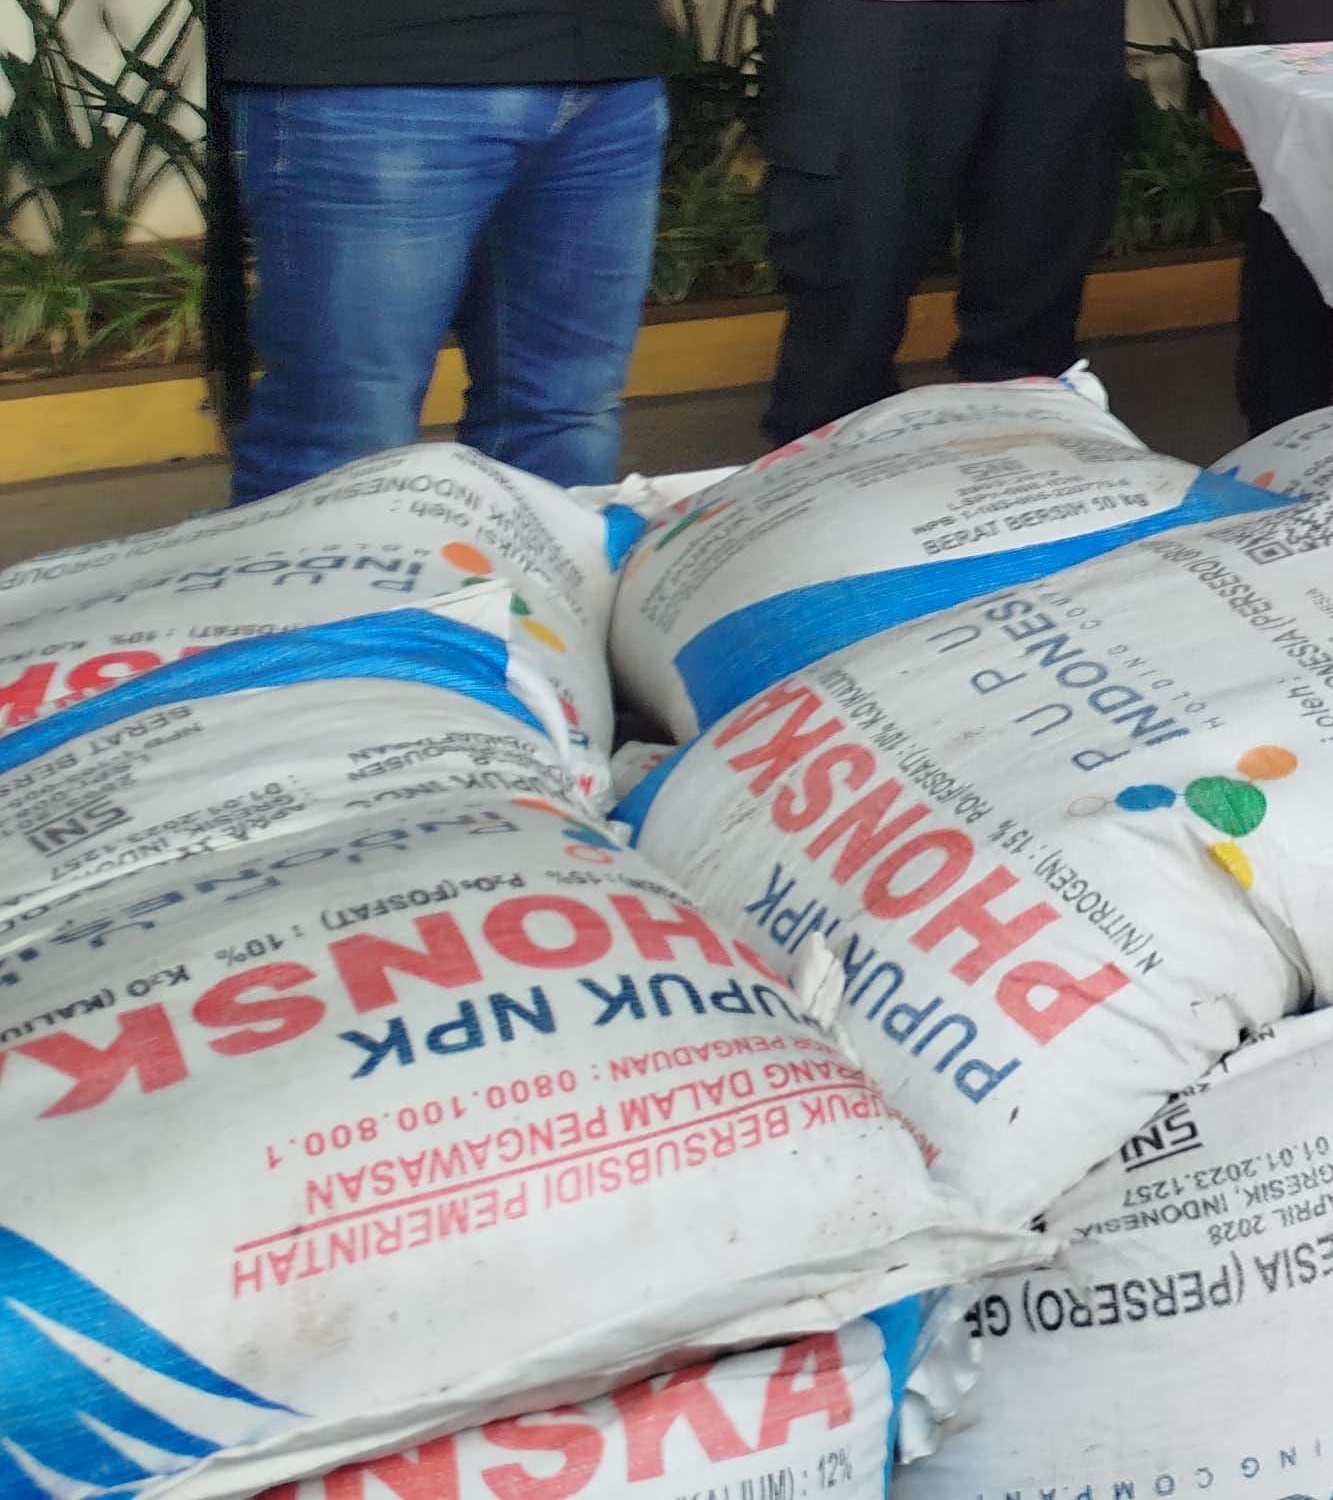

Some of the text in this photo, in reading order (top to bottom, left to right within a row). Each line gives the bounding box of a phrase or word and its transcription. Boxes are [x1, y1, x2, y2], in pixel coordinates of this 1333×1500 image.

[923, 501, 1089, 556] BERAT BERSIH
[978, 593, 1189, 750] INDONESI
[24, 798, 128, 858] SNI
[711, 678, 1131, 1047] PHONSKA
[214, 928, 287, 969] 10%
[0, 893, 788, 1120] HONSK
[339, 986, 552, 1079] NPK
[610, 1035, 785, 1084] PENGADUAN
[304, 1066, 751, 1216] DALAM PENGAWASAN
[231, 1103, 789, 1298] BERSUBSIDI PEMERINTAH
[1073, 1194, 1227, 1243] INDONESIA
[1020, 1252, 1245, 1334] (PERSERO)
